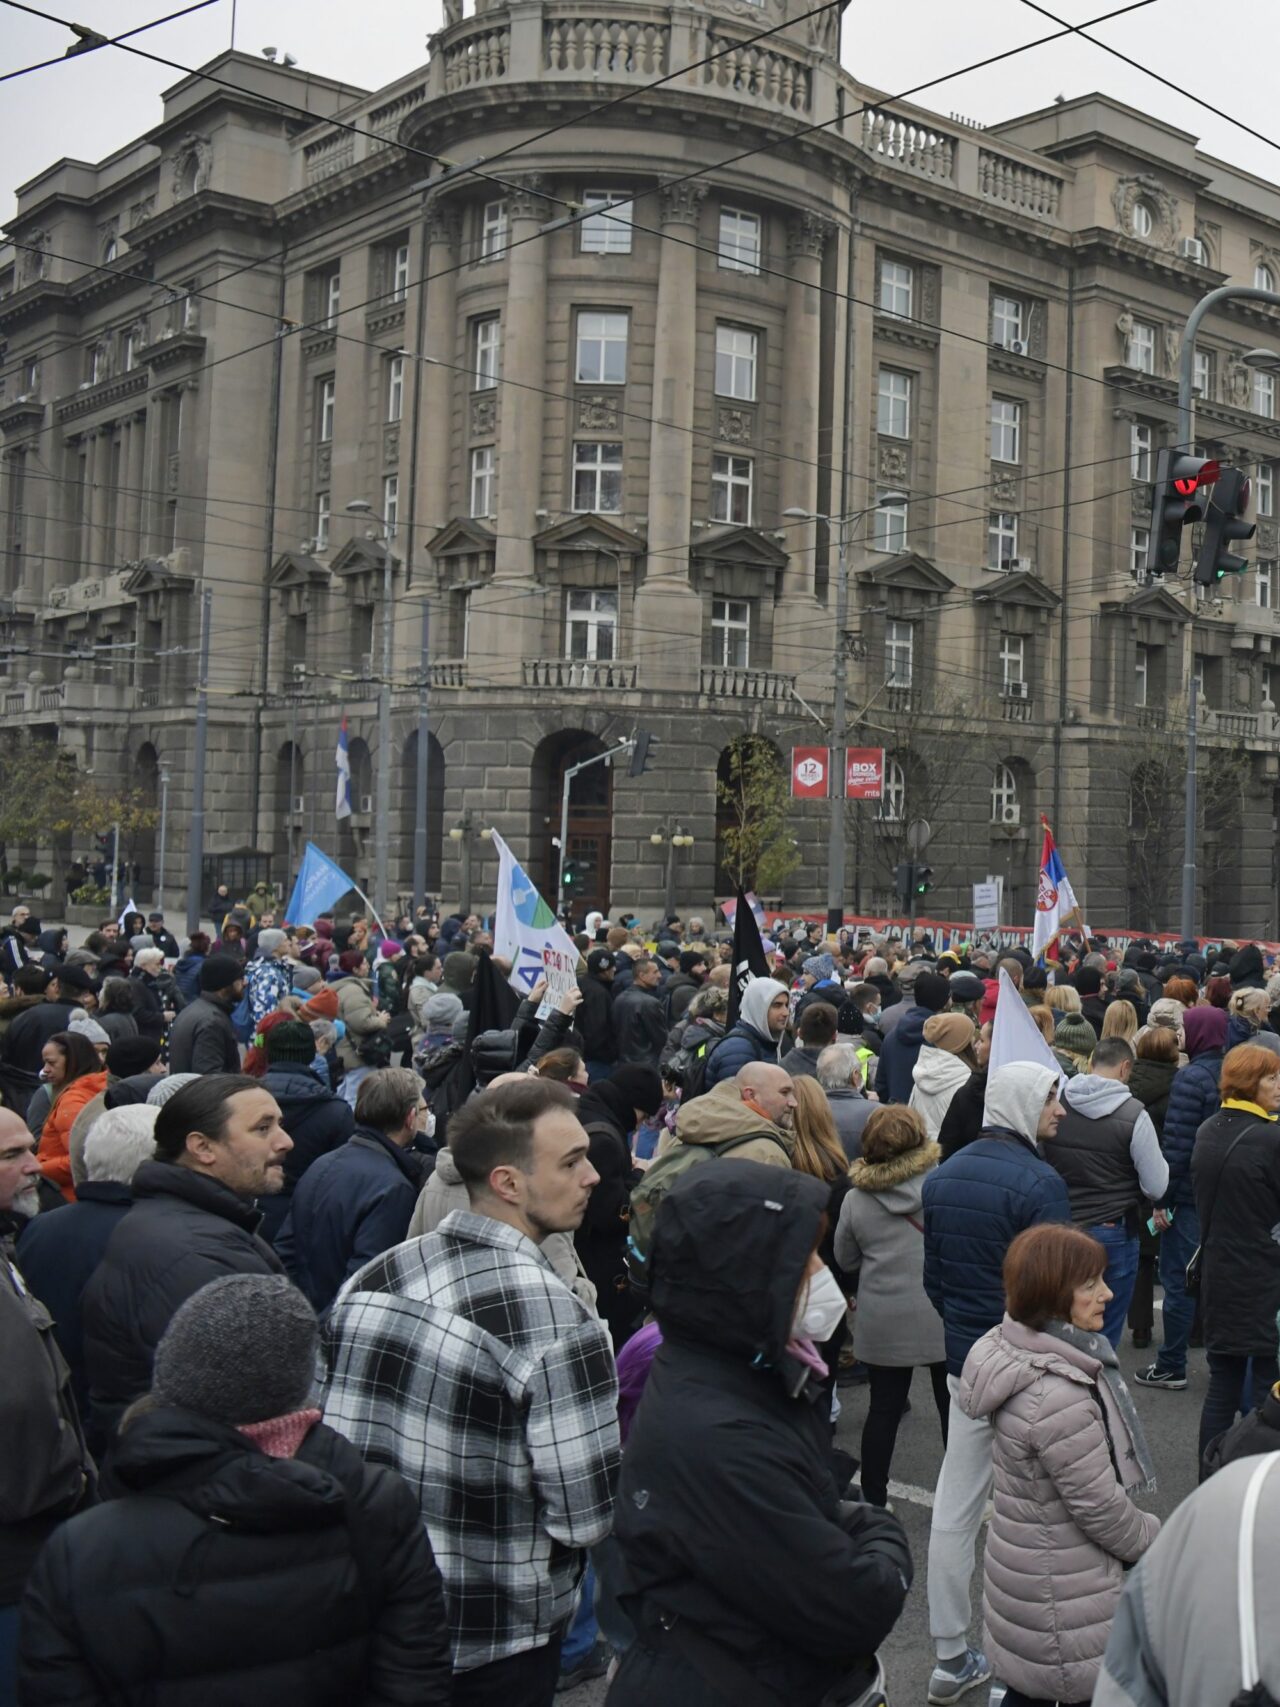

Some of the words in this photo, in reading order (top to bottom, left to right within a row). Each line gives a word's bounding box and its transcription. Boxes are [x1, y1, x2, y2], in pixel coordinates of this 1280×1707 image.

[803, 763, 817, 774] 12
[852, 763, 877, 772] BOX
[864, 790, 881, 798] mts
